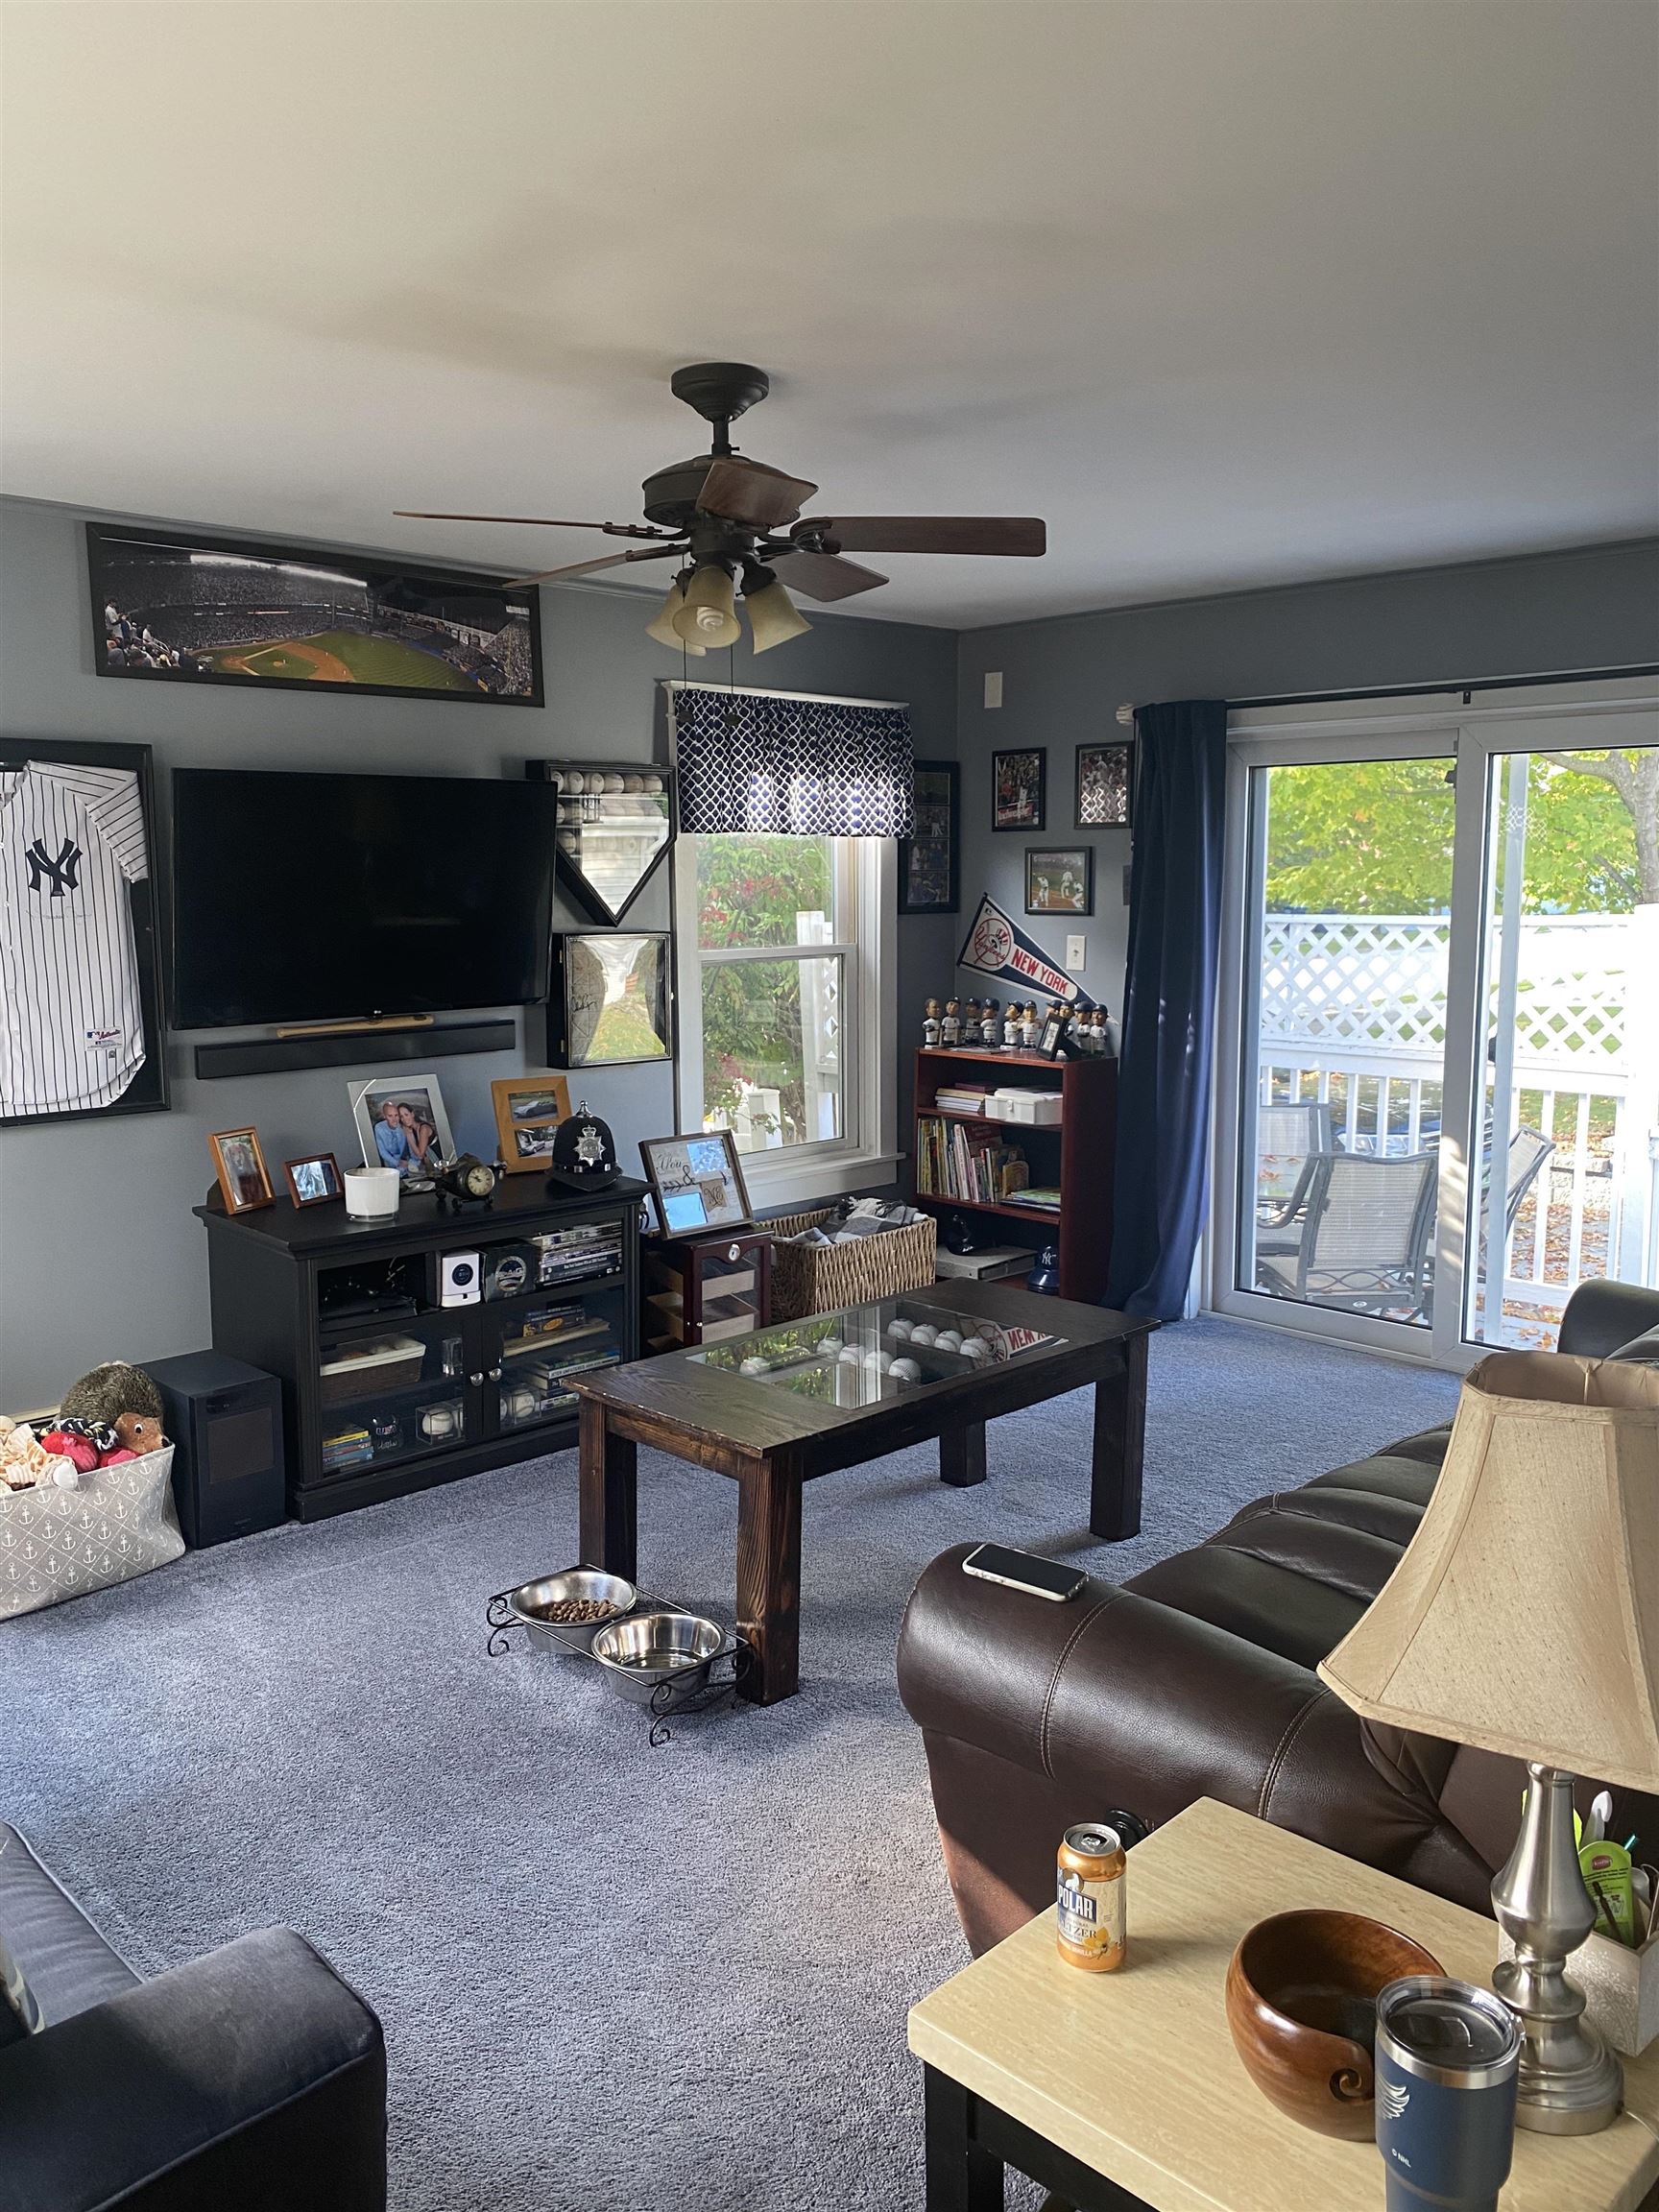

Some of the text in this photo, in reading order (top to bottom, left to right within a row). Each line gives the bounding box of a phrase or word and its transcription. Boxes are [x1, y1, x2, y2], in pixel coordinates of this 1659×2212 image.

[25, 838, 84, 897] NY
[1011, 949, 1069, 995] NEW YORK
[656, 1153, 683, 1175] You
[1058, 1884, 1094, 1920] POLAR
[1398, 2152, 1412, 2167] NHL
